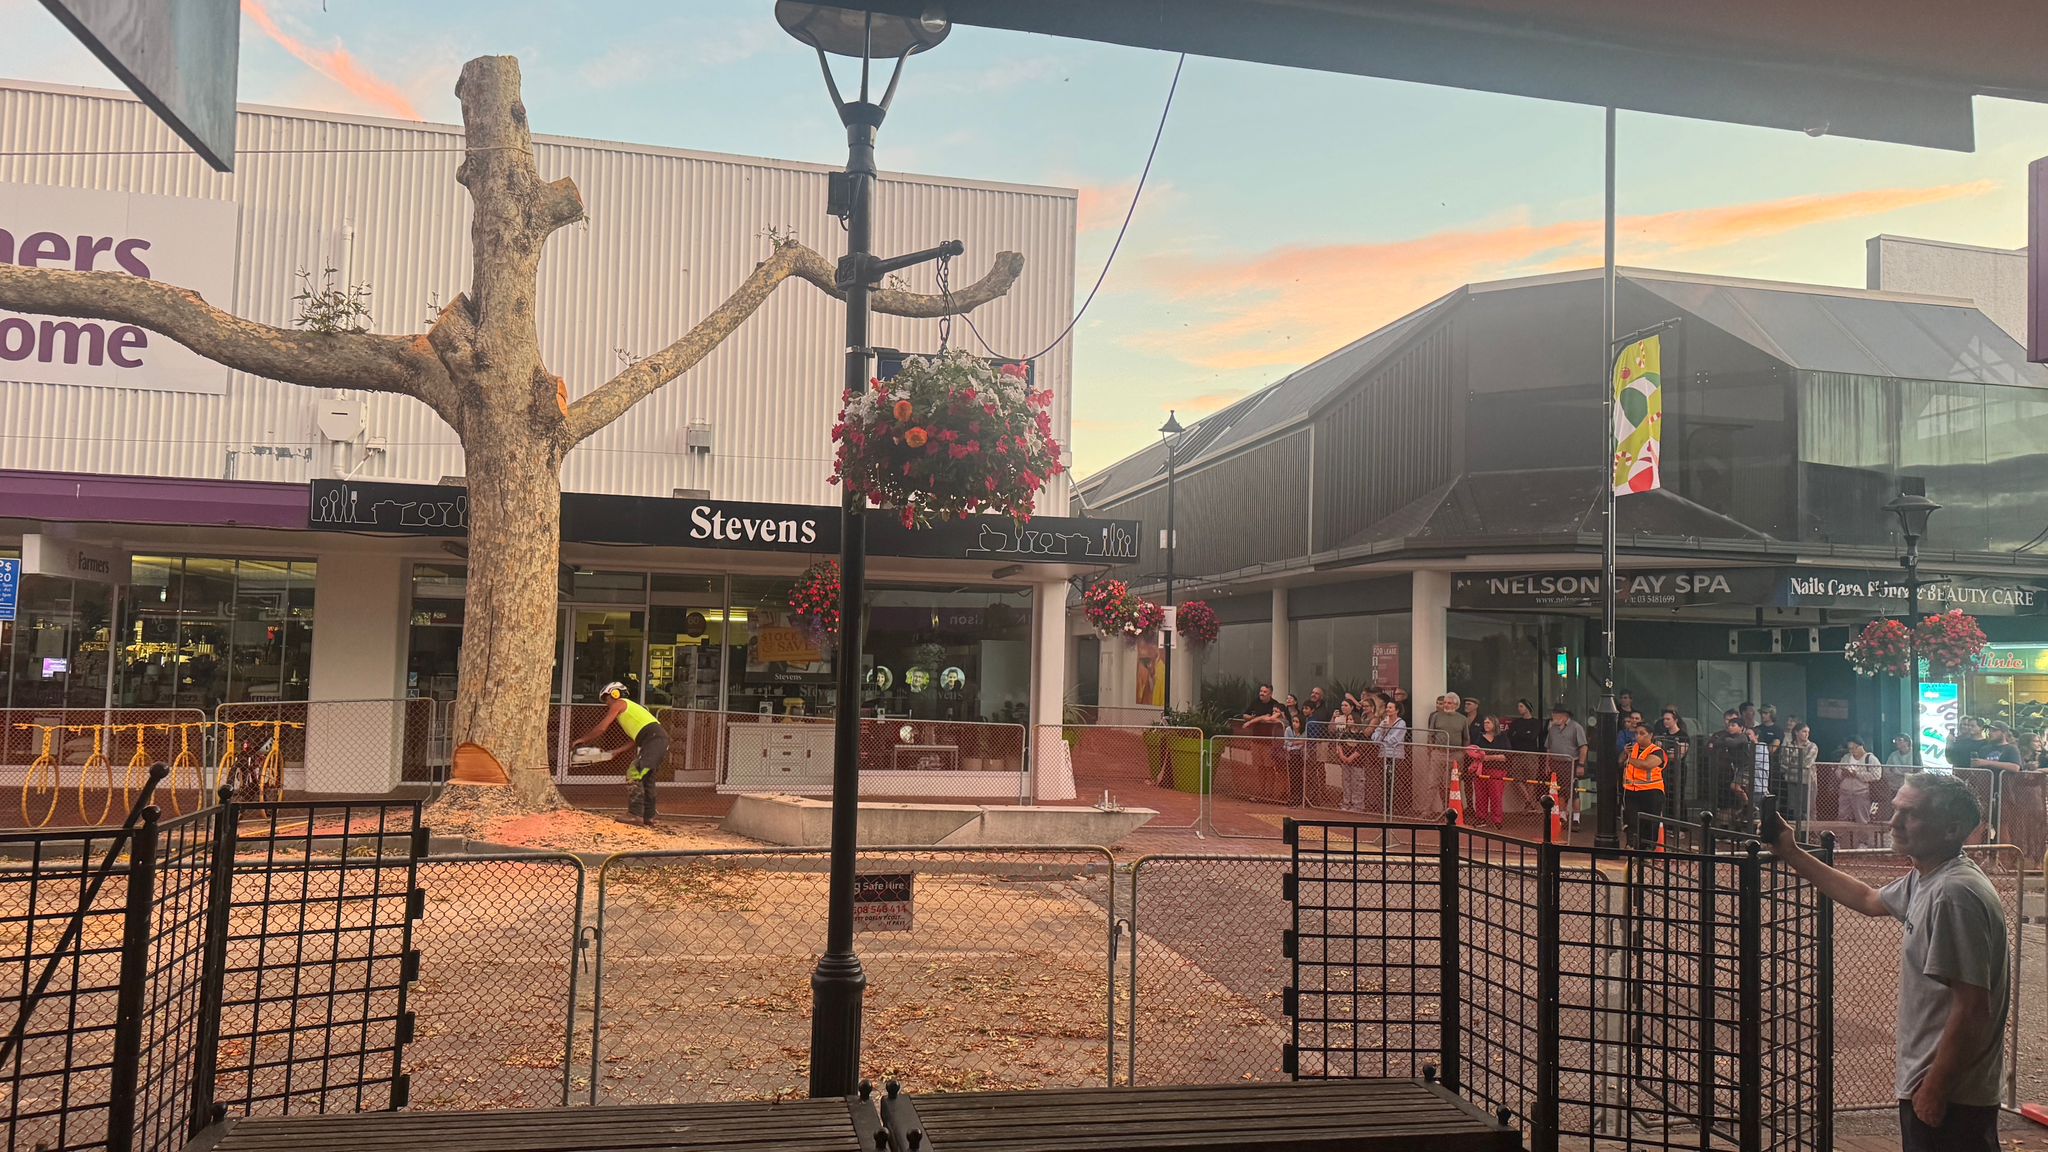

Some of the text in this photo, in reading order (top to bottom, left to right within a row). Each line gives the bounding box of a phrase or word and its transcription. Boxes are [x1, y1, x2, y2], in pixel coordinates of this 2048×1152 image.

[0, 228, 151, 279] ers
[690, 505, 816, 544] Stevens
[78, 551, 110, 574] Farmers
[1489, 576, 1600, 595] NELSON
[1674, 575, 1732, 594] SPA
[1790, 577, 1825, 595] Nails
[1991, 590, 2034, 606] CARE
[774, 672, 802, 681] Stevens
[863, 881, 884, 890] Safe
